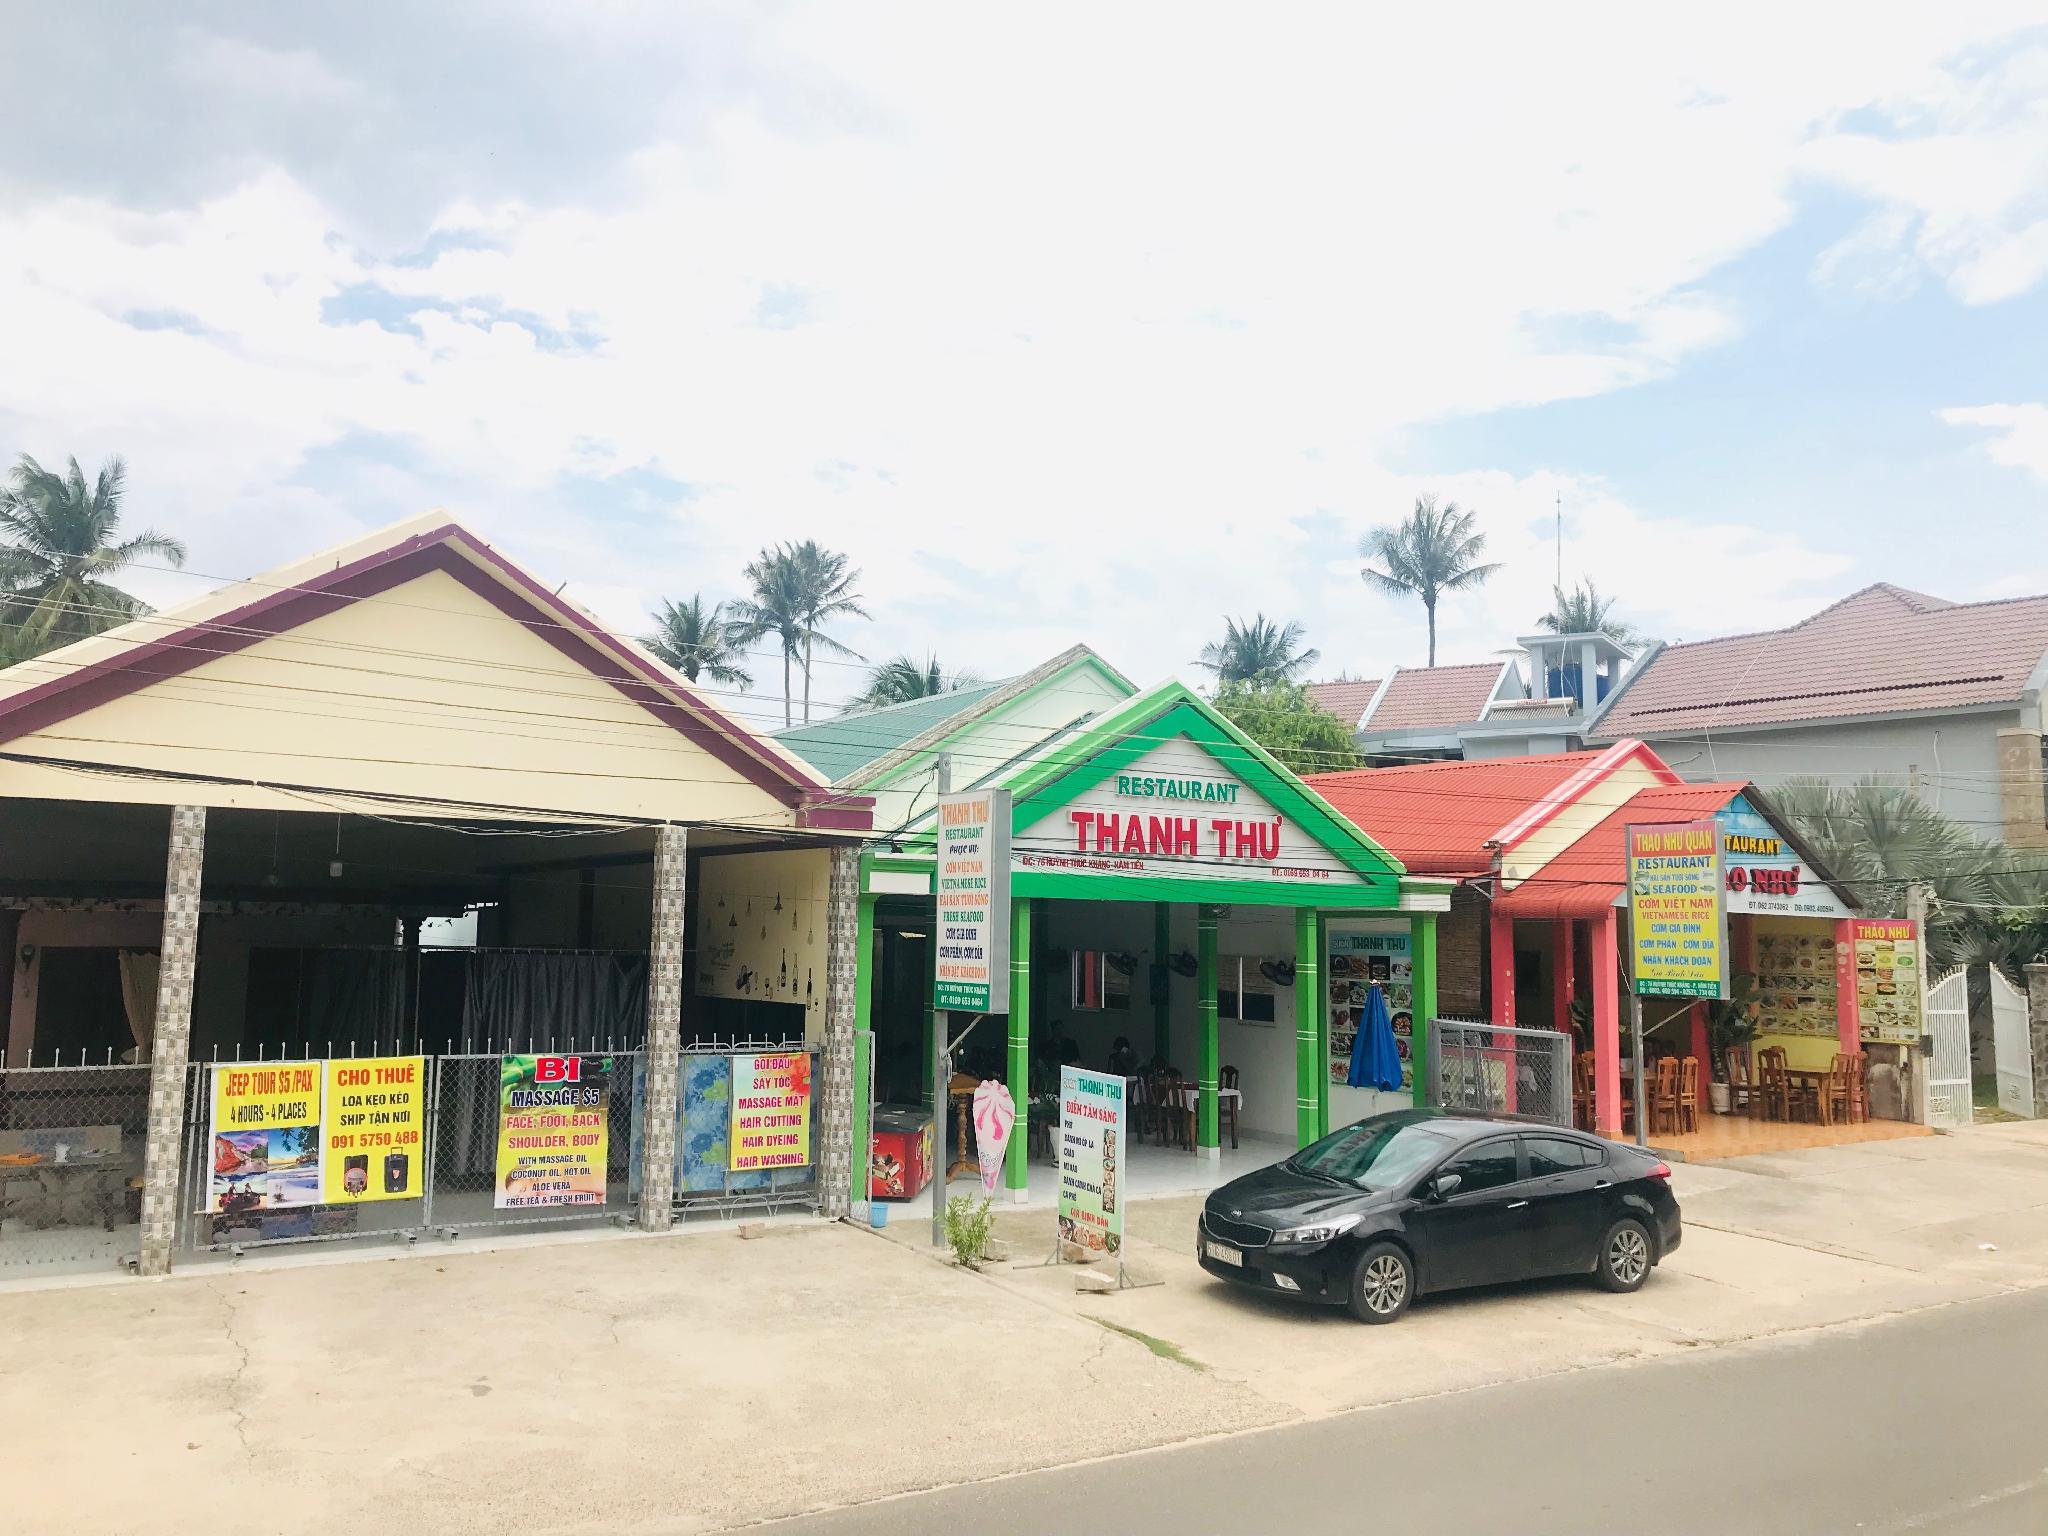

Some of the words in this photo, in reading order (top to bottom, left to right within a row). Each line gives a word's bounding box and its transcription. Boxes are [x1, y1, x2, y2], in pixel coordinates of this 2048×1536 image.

[1117, 775, 1239, 802] RESTAURANT
[945, 827, 984, 840] RESTAURANT
[1070, 811, 1198, 857] THANH
[1211, 815, 1284, 861] THƯ
[1725, 835, 1781, 854] TAURANT
[1638, 856, 1711, 870] RESTAURANT
[942, 878, 974, 889] VIETNAMESE
[974, 878, 987, 888] RICE
[1652, 884, 1698, 894] SEAFOOD
[1639, 898, 1660, 909] CƠM
[1663, 897, 1686, 910] VIỆT
[1690, 898, 1713, 909] NAM
[943, 911, 959, 922] FRESH
[960, 911, 984, 922] SEAFOOD
[1642, 911, 1689, 920] VIETNAMESE
[1692, 911, 1710, 920] RICE
[1857, 922, 1886, 939] THẢO
[1888, 923, 1912, 938] NHƯ
[1351, 936, 1384, 950] THANH
[337, 1068, 370, 1086] CHO
[375, 1064, 415, 1085] THUÊ
[534, 1057, 581, 1083] BI
[226, 1072, 249, 1097] JEEP
[252, 1071, 276, 1096] TOUR
[279, 1070, 290, 1095] $5
[292, 1069, 313, 1093] /PAX
[774, 1075, 791, 1088] TÓC
[1078, 1078, 1104, 1096] THANH
[342, 1095, 362, 1107] LOA
[366, 1094, 386, 1109] KẸO
[389, 1090, 409, 1105] KÉO
[511, 1089, 579, 1107] MASSAGE
[582, 1087, 600, 1106] $5
[738, 1096, 782, 1109] MASSAGE
[231, 1107, 236, 1123] 4
[238, 1105, 264, 1123] HOURS
[271, 1104, 276, 1121] 4
[278, 1101, 307, 1120] PLACES
[340, 1114, 365, 1126] SHIP
[369, 1110, 390, 1127] TẬN
[393, 1110, 411, 1123] NƠI
[1099, 1106, 1117, 1124] SÁNG
[506, 1116, 537, 1129] FACE,
[540, 1115, 569, 1128] FOOT,
[571, 1114, 600, 1127] BACK
[740, 1117, 761, 1129] HAIR
[764, 1115, 802, 1127] CUTTING
[331, 1135, 354, 1149] 091
[359, 1133, 391, 1147] 5750
[395, 1130, 418, 1145] 488
[508, 1135, 569, 1149] SHOULDER,
[572, 1134, 600, 1146] BODY
[742, 1136, 764, 1148] HAIR
[766, 1134, 798, 1146] DYEING
[518, 1157, 536, 1165] WITH
[539, 1155, 573, 1164] MASSAGE
[576, 1155, 587, 1163] OIL
[737, 1155, 759, 1168] HAIR
[761, 1153, 804, 1166] WASHING
[512, 1170, 547, 1179] COCONUT
[564, 1168, 578, 1176] HOT
[580, 1167, 591, 1175] OIL
[532, 1182, 551, 1192] ALOE
[552, 1182, 571, 1190] VERA
[506, 1198, 525, 1206] FREE
[526, 1197, 540, 1205] TEA
[550, 1195, 573, 1204] FRESH
[574, 1193, 595, 1203] FRUIT
